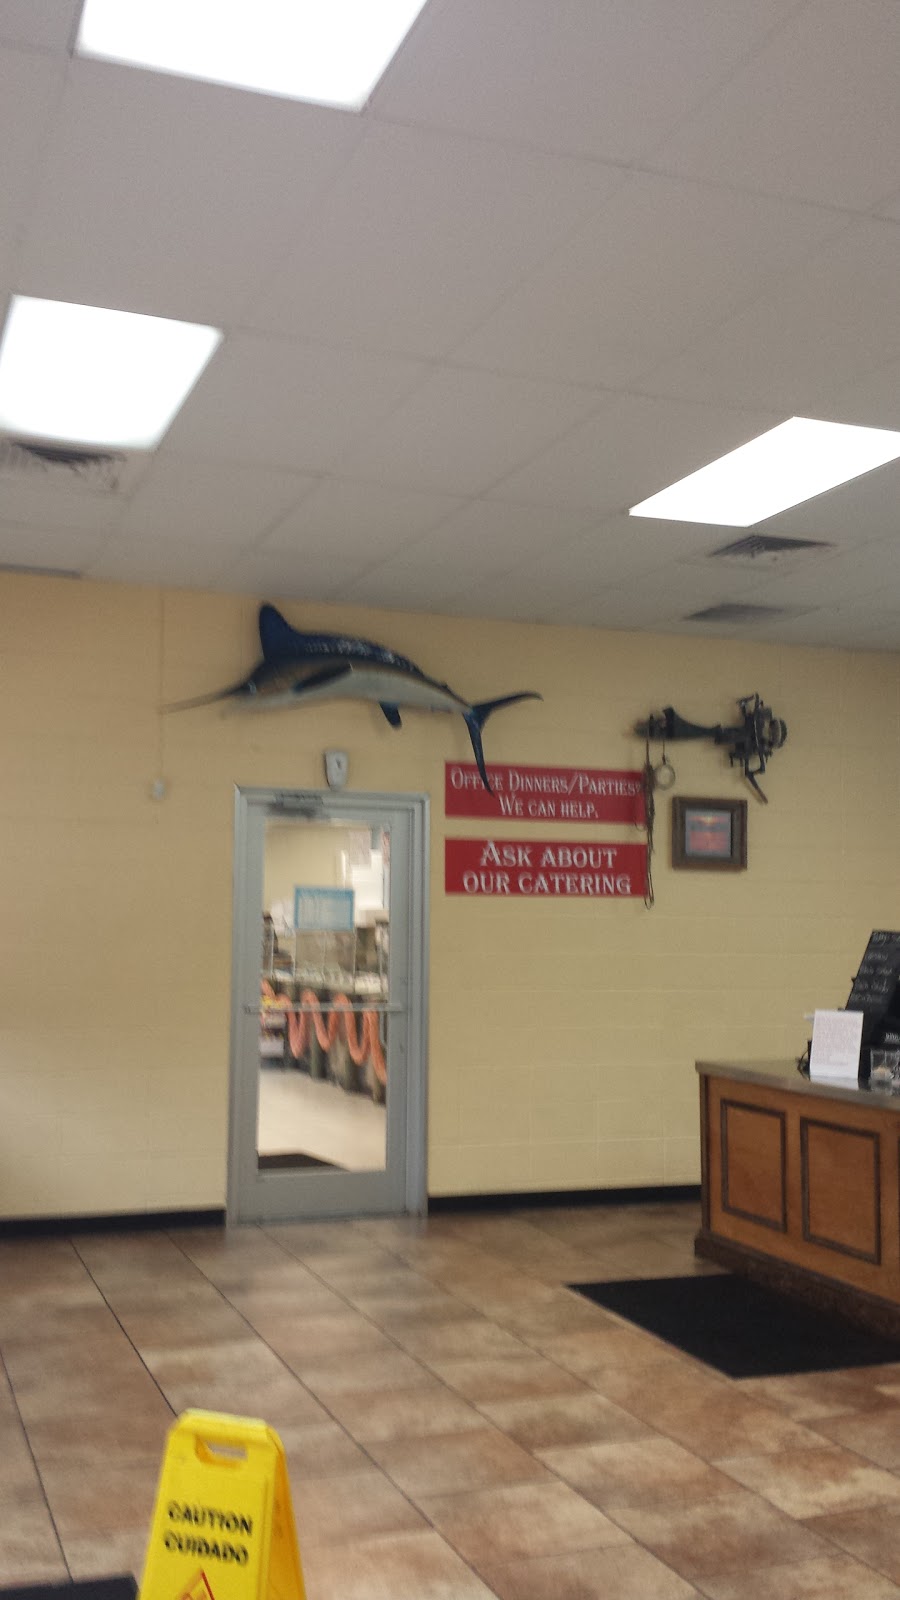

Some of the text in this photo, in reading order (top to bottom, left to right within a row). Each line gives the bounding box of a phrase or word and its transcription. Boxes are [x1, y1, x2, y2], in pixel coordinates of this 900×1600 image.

[528, 800, 555, 817] CAN
[480, 840, 617, 869] ASK ABOUT
[463, 871, 632, 895] OUR CATERING
[168, 1501, 253, 1535] CAUTION
[164, 1530, 249, 1566] CUIDADO
